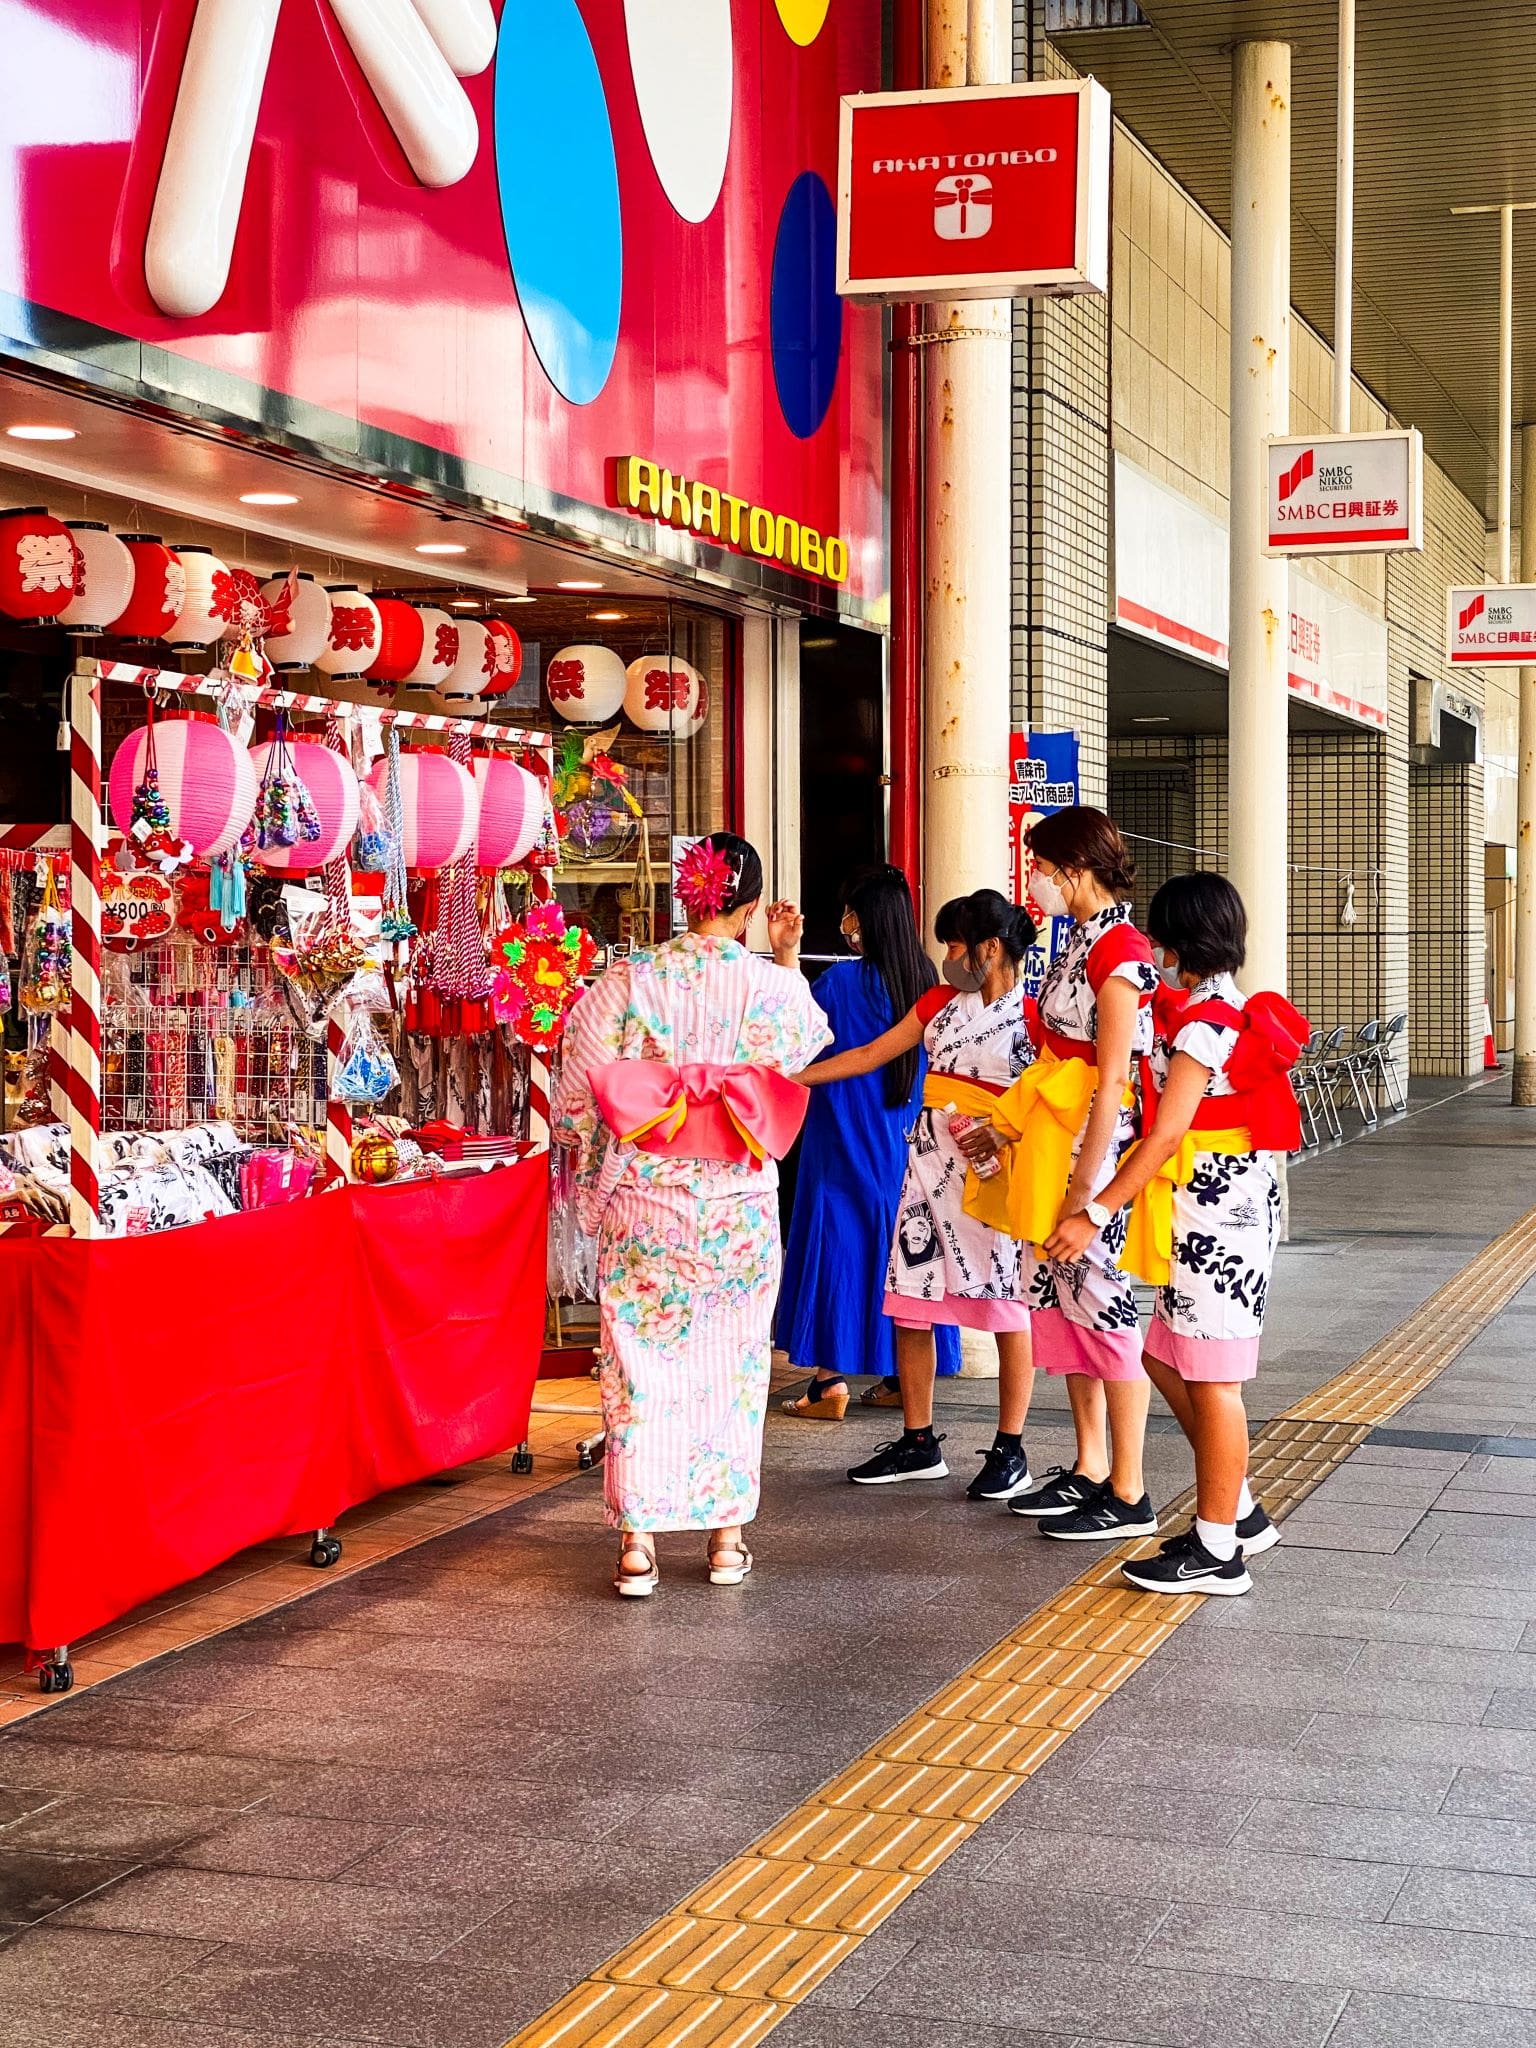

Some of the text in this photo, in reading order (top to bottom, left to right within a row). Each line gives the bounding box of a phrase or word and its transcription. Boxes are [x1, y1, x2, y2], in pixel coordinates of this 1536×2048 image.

[873, 148, 1058, 174] AKATONBO
[1319, 465, 1353, 478] SMBC
[1319, 475, 1353, 487] NIKKO
[624, 455, 848, 584] AKATONBO
[1277, 499, 1399, 521] SMBC日興証券
[17, 534, 74, 593] 祭
[1487, 606, 1513, 615] SMBC
[1487, 613, 1513, 621] NIKKO
[329, 606, 376, 651] 祭
[1458, 630, 1536, 644] SMBC日興証
[547, 660, 585, 701] 祭
[645, 669, 690, 711] 祭
[1016, 761, 1046, 780] 青森市
[1009, 784, 1074, 804] ミアム付商品券
[105, 902, 148, 920] ¥800
